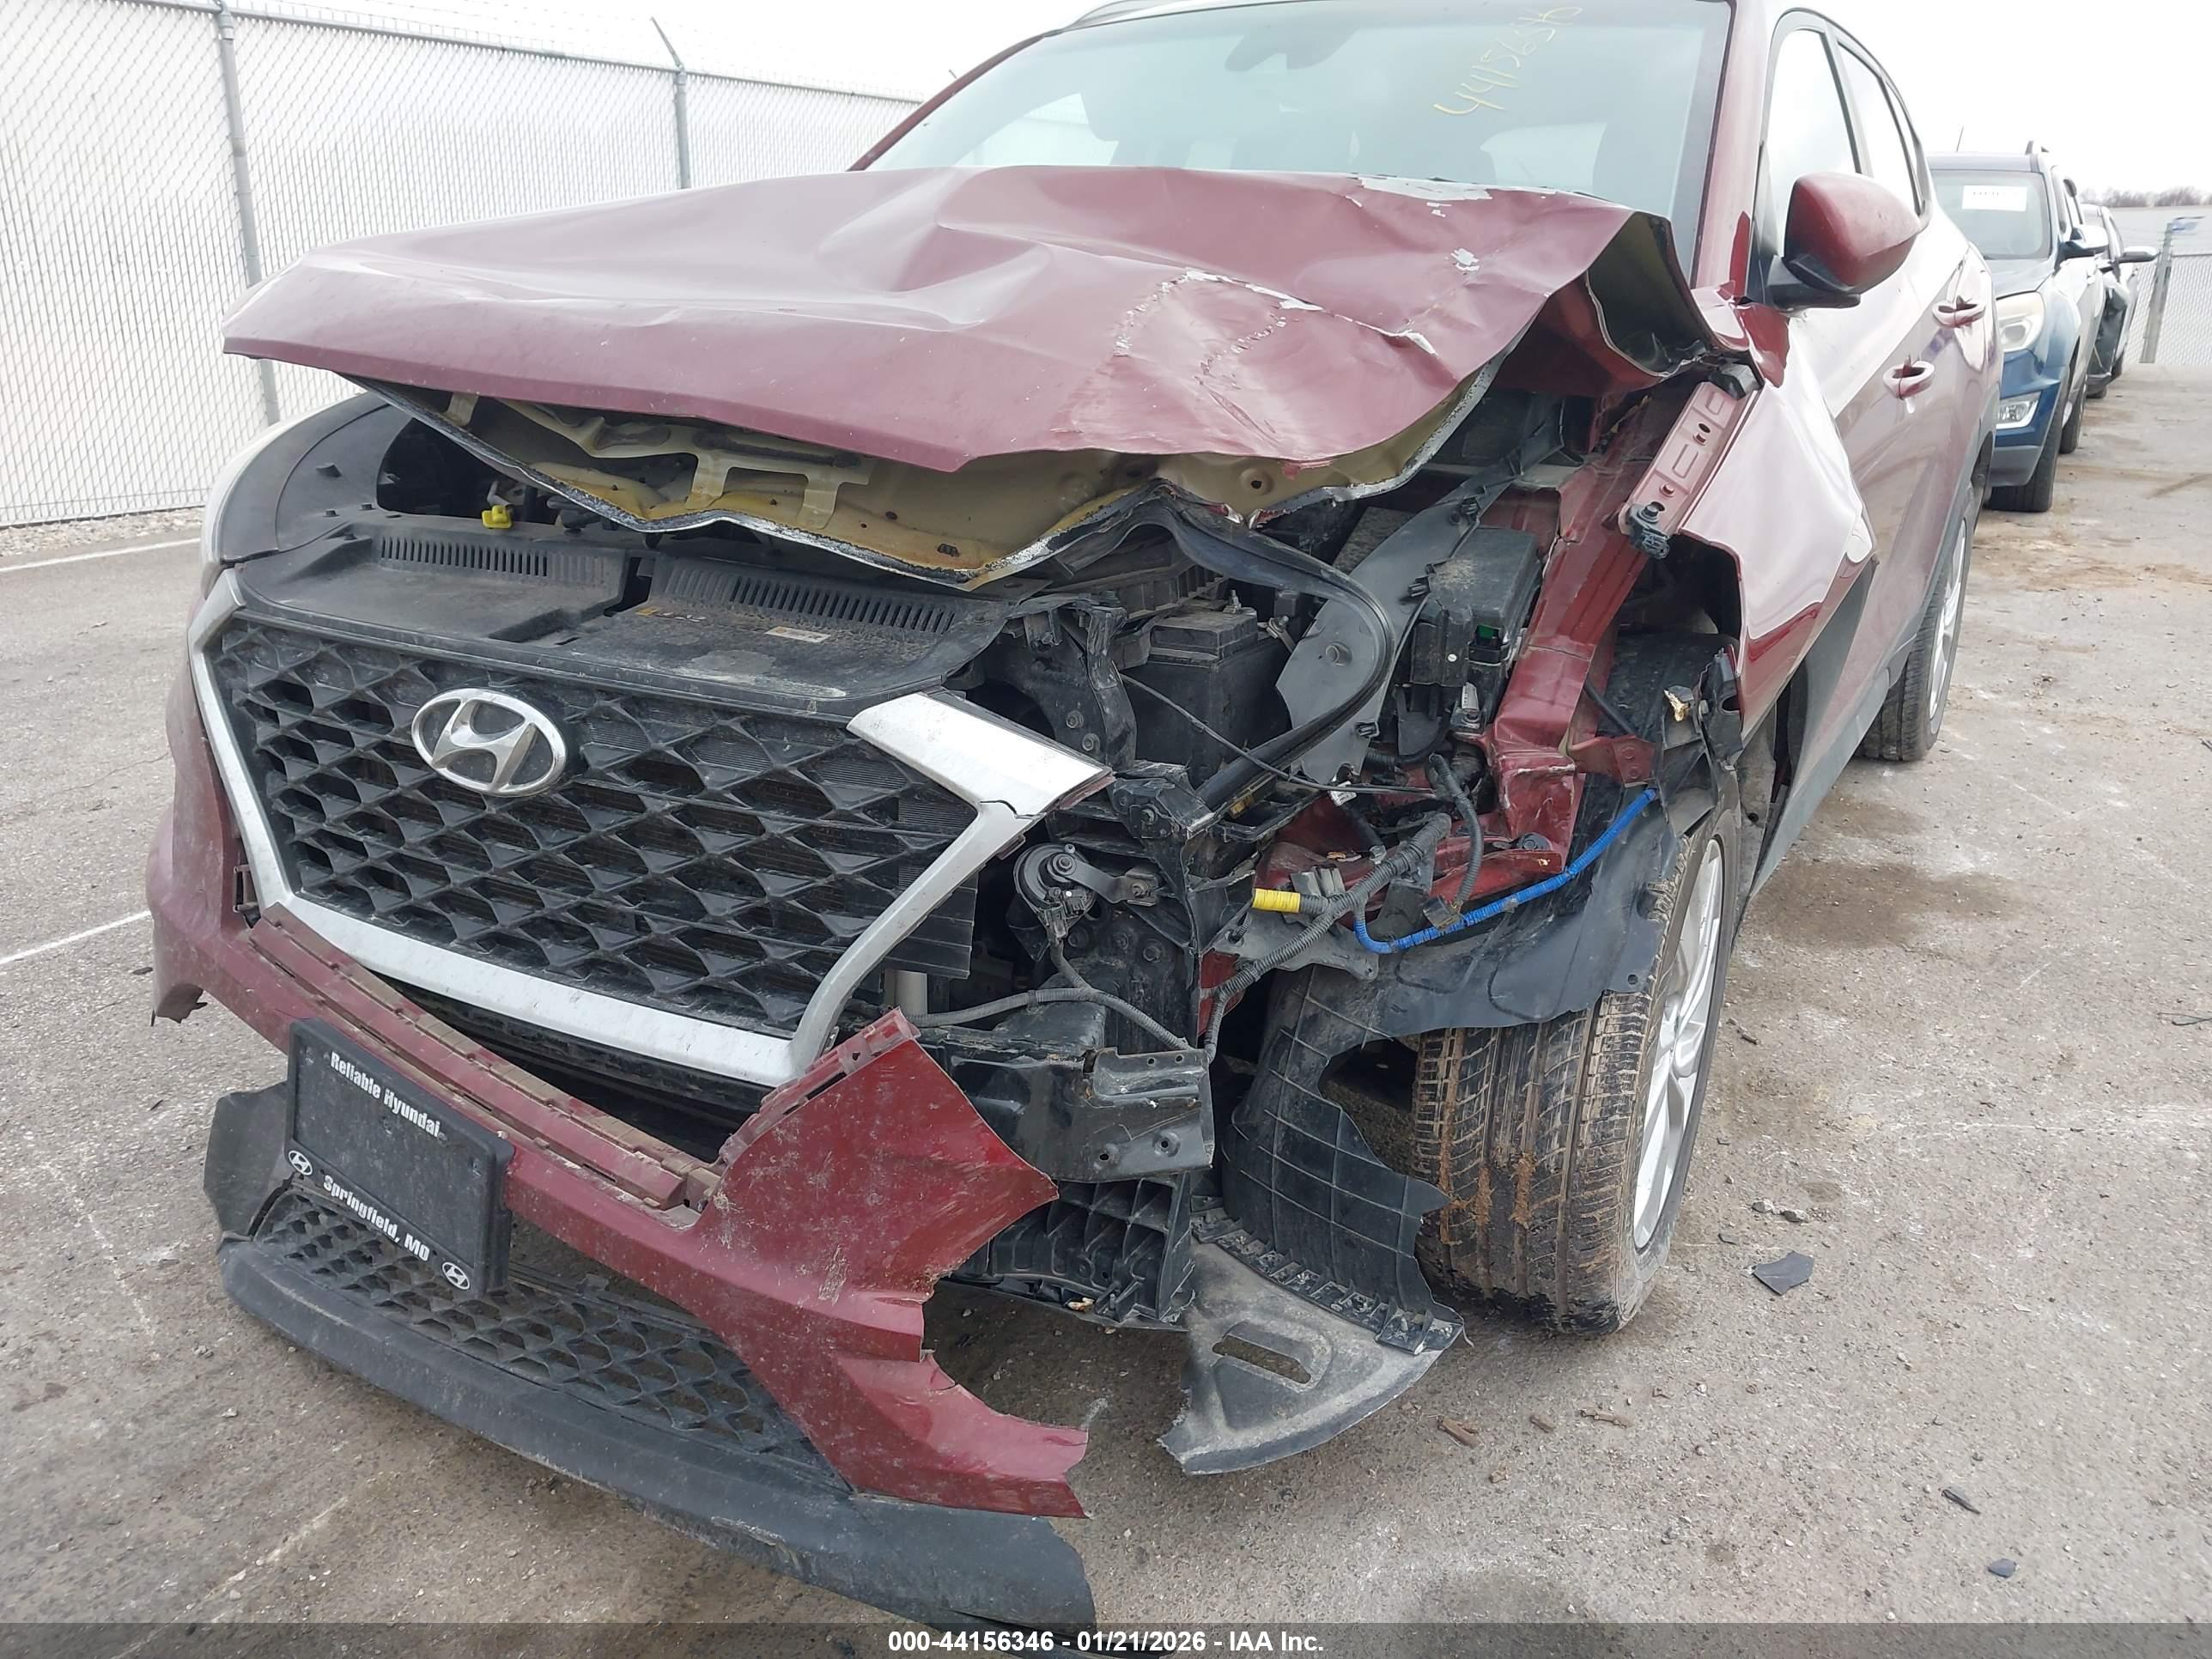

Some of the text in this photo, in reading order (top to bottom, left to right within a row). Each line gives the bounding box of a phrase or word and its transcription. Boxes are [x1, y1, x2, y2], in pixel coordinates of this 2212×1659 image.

[330, 1050, 441, 1138] Reliable Hyundai
[323, 1174, 430, 1261] Springfield, MO
